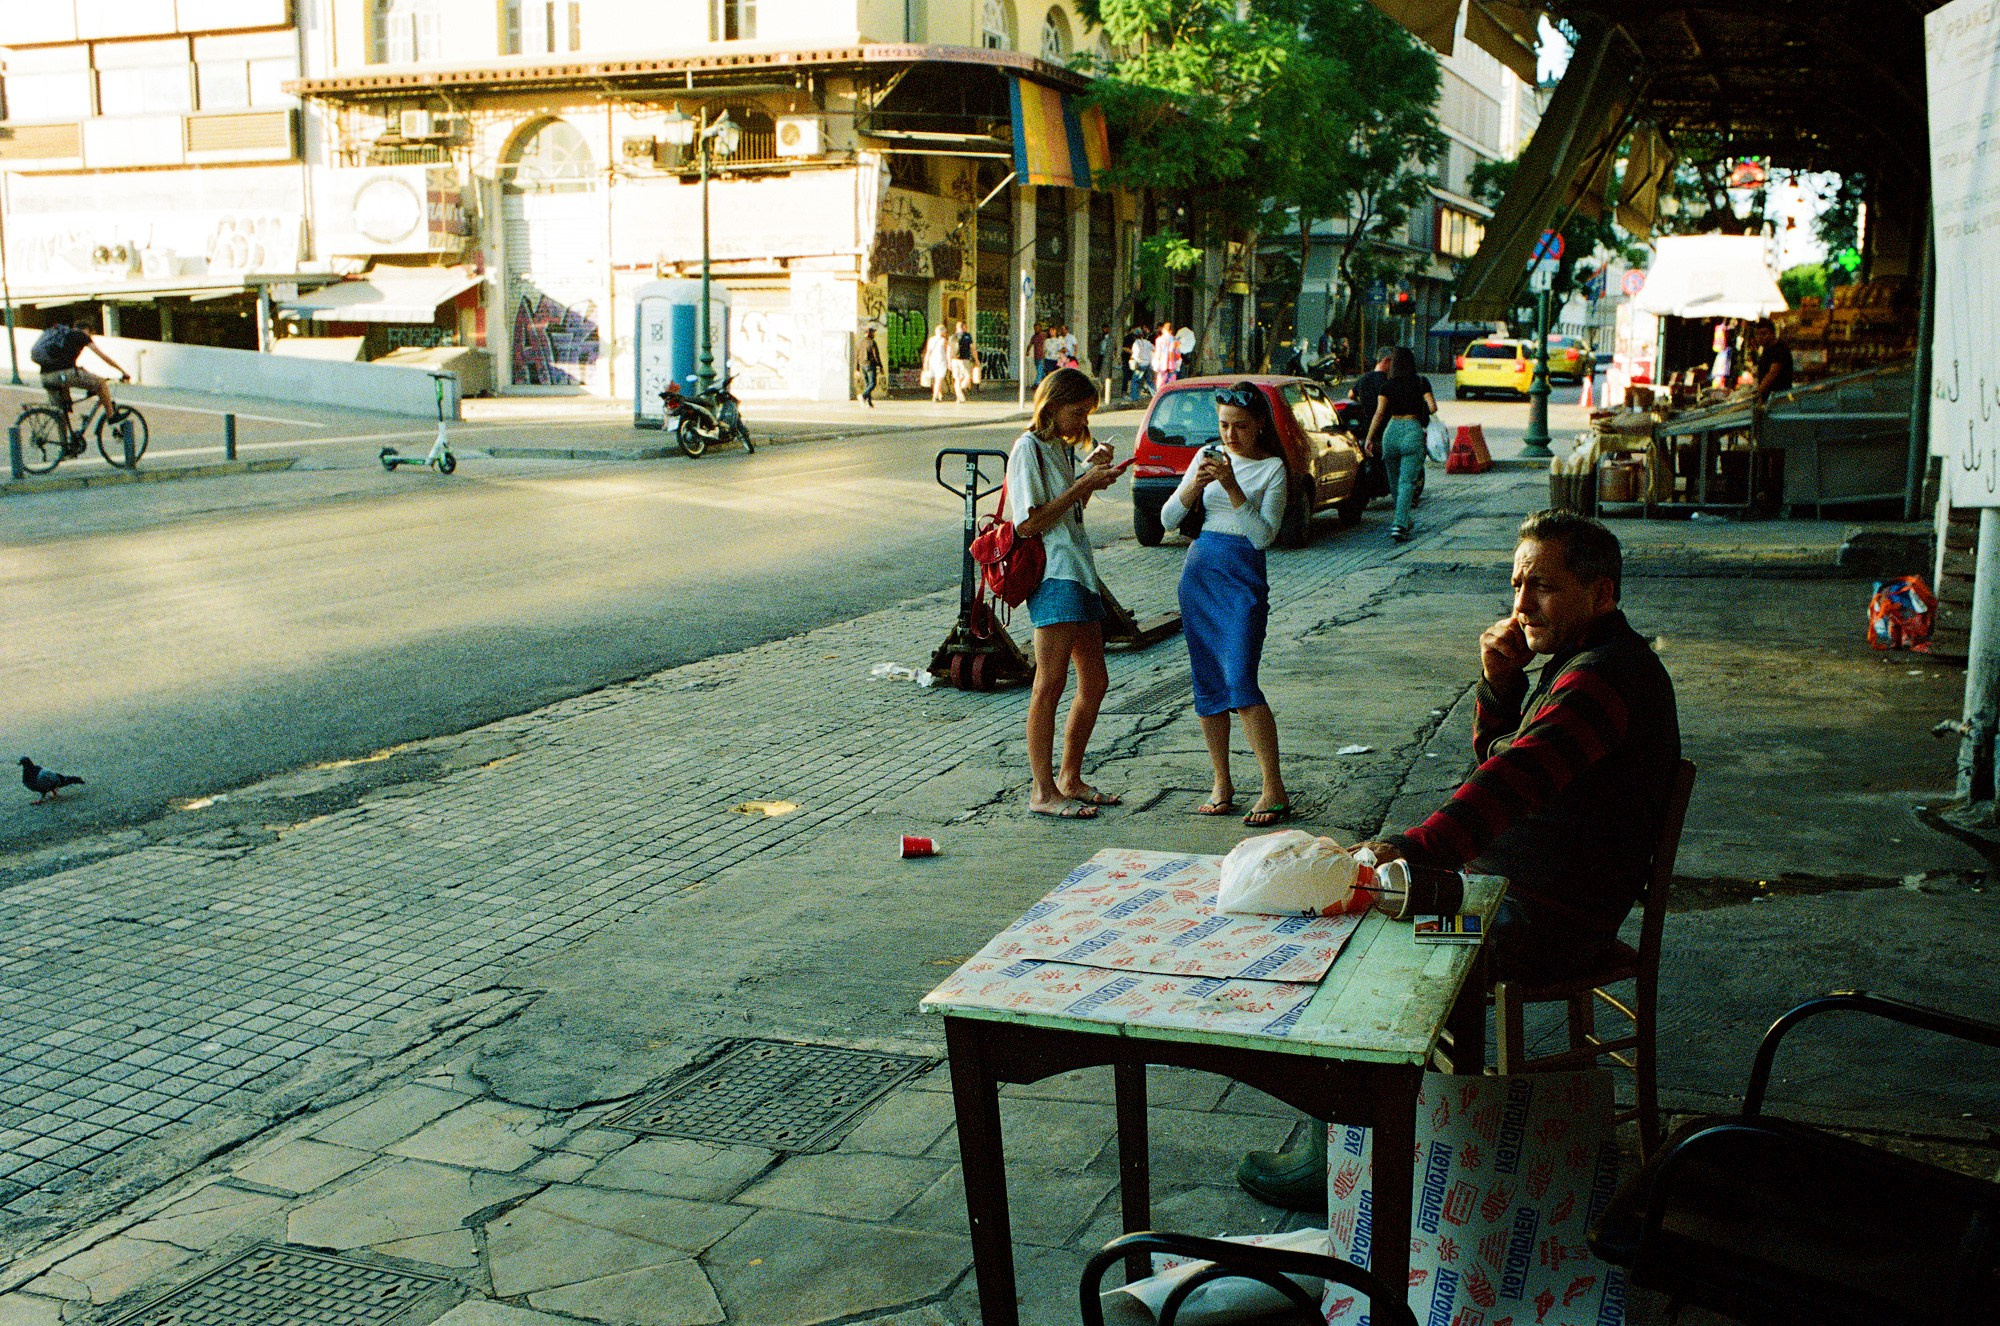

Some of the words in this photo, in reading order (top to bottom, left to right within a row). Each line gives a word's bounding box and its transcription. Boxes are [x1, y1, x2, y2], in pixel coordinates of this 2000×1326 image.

[1495, 1079, 1530, 1174] ΙΧΘΥΟΠΩΛΕΙΟ
[1350, 1189, 1372, 1267] ΘΥΟΠΩΛΕΙΟ
[1421, 1142, 1452, 1234] ΙΧΘΥΟΠΩΛΕΙΟ
[1500, 1207, 1535, 1299] ΙΧΘΥΟΠΩΛΕΙΟ
